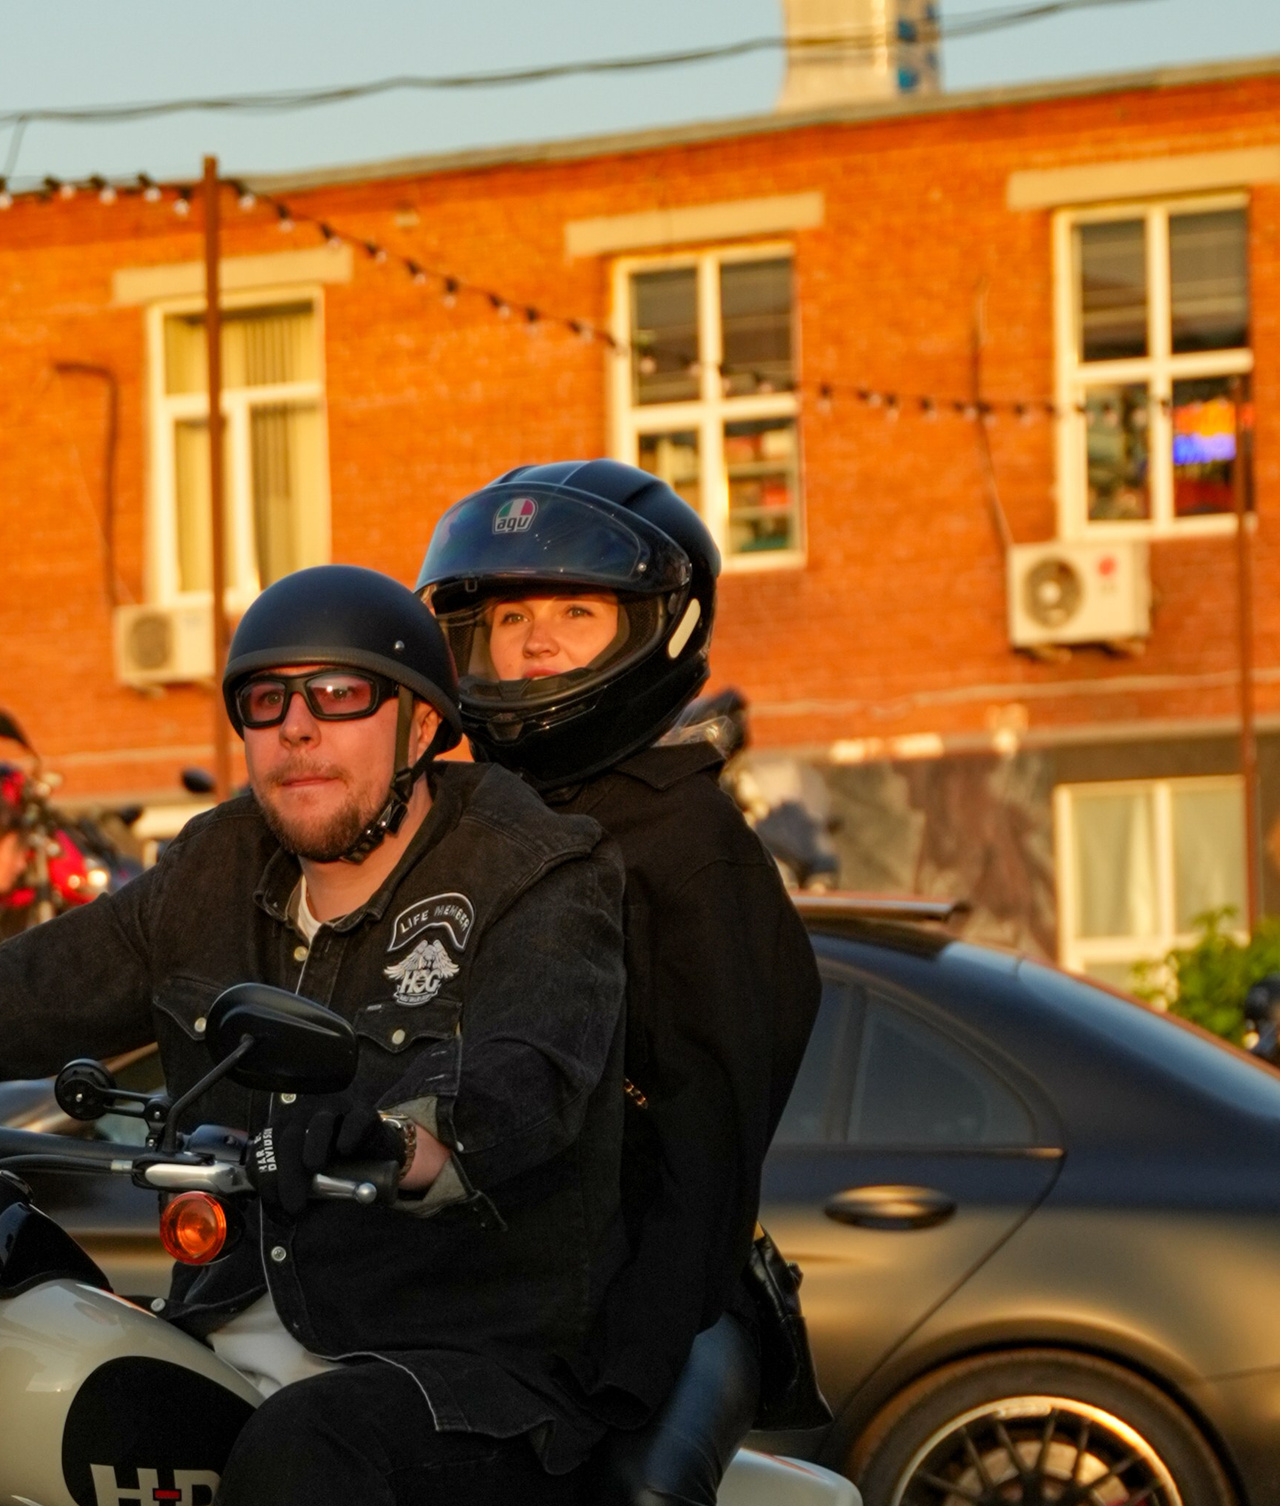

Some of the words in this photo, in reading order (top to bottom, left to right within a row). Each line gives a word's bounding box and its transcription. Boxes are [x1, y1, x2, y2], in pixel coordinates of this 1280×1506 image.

[496, 516, 530, 532] agv
[400, 909, 430, 933] LIFE
[433, 904, 470, 931] MEMBER
